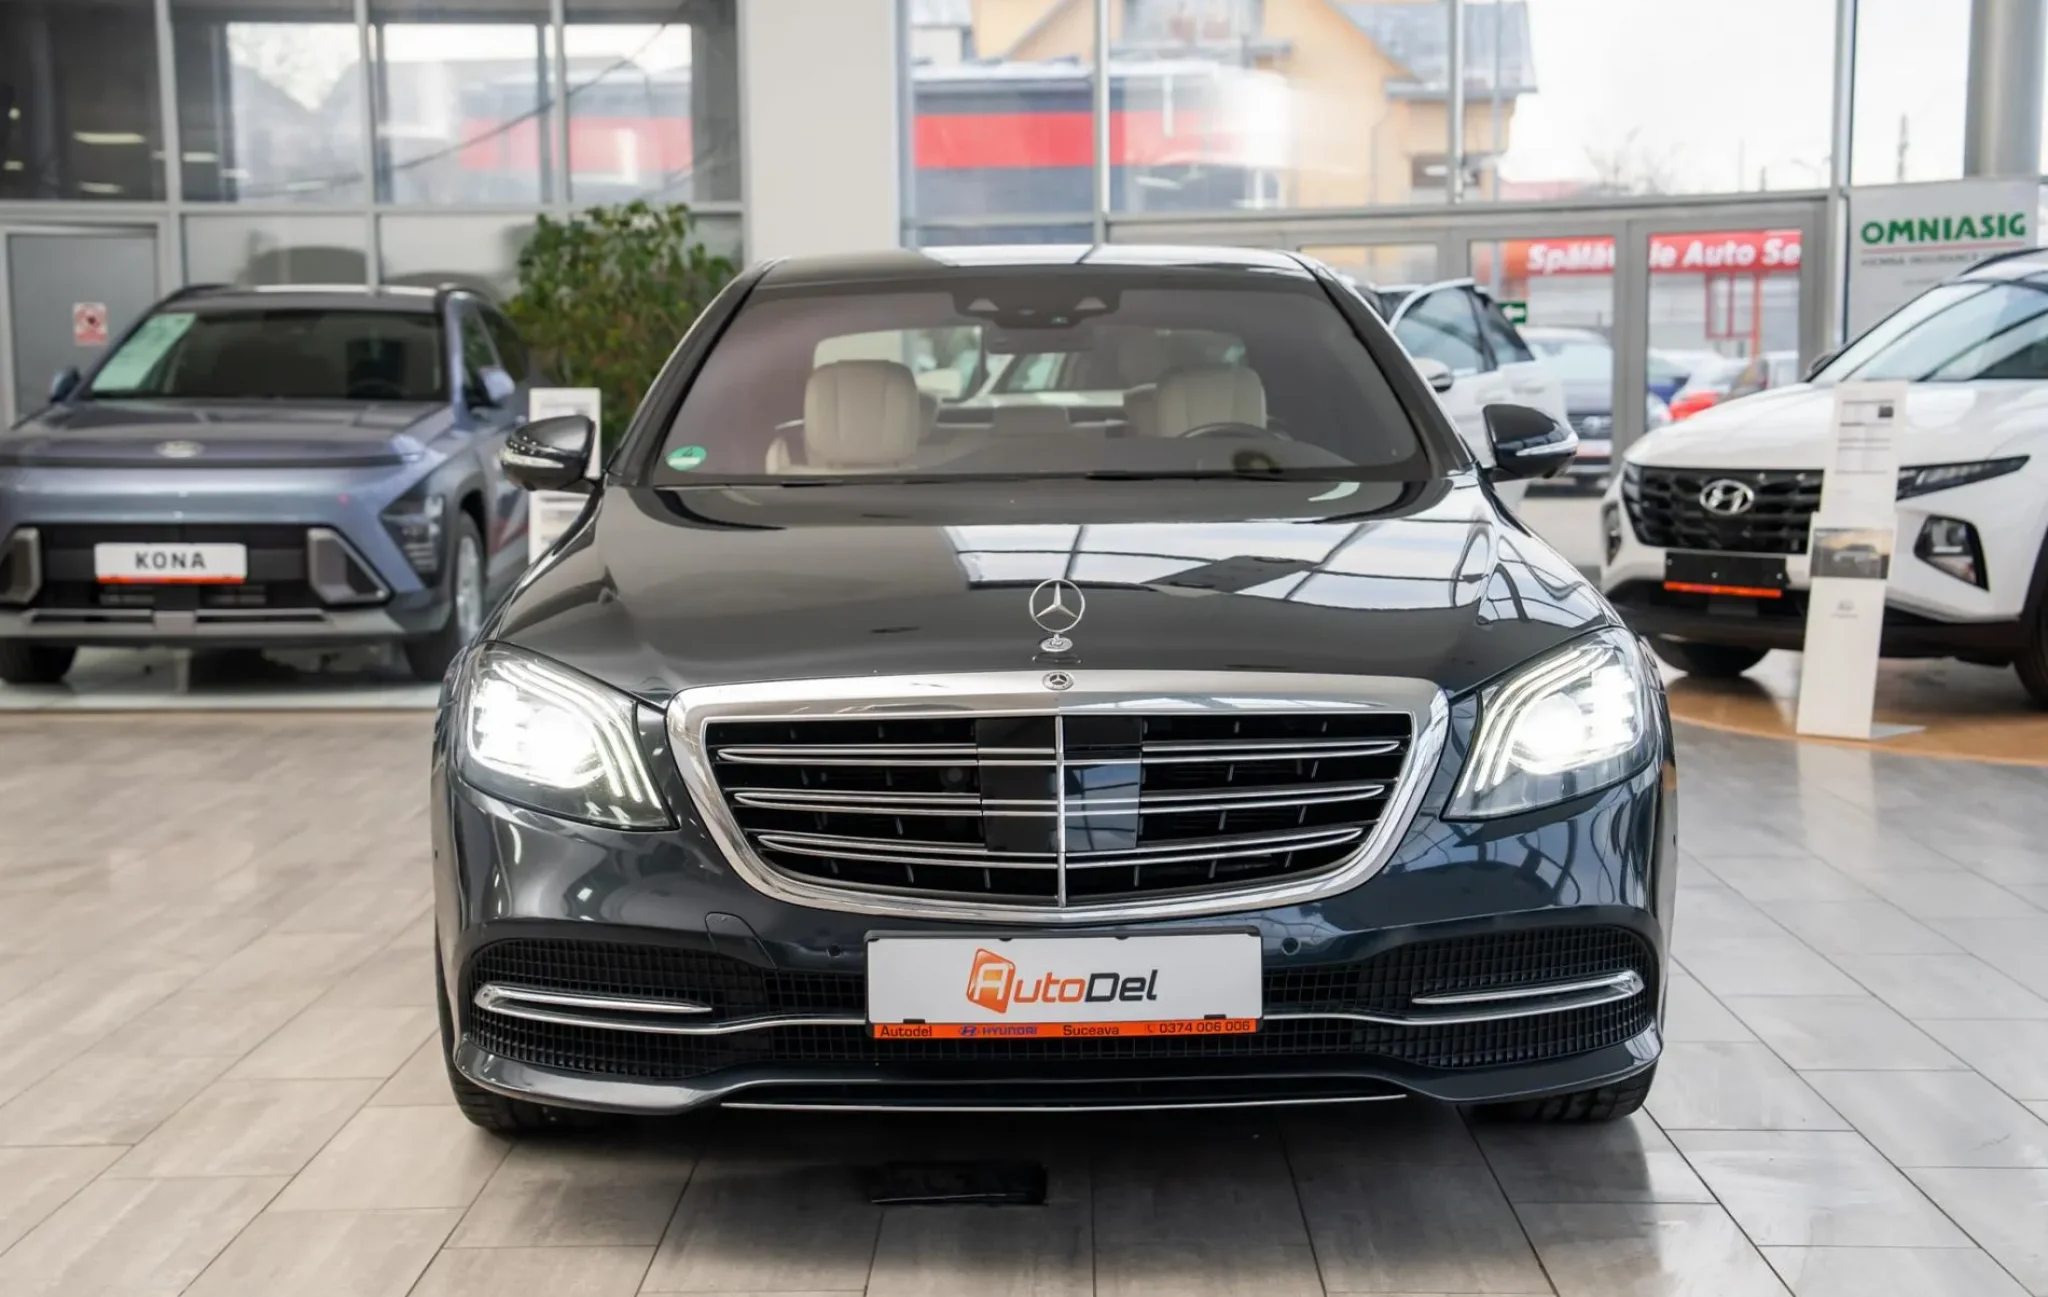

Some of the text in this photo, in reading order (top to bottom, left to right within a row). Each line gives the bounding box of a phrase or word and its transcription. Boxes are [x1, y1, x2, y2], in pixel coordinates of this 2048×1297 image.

[1861, 212, 2026, 244] OMNIASIG
[1682, 240, 1756, 268] Auto
[135, 551, 206, 569] KONA
[970, 960, 1159, 1004] AutoDel
[880, 1020, 1251, 1037] Autodel HYUNDAI Suceava 0374 006 006
